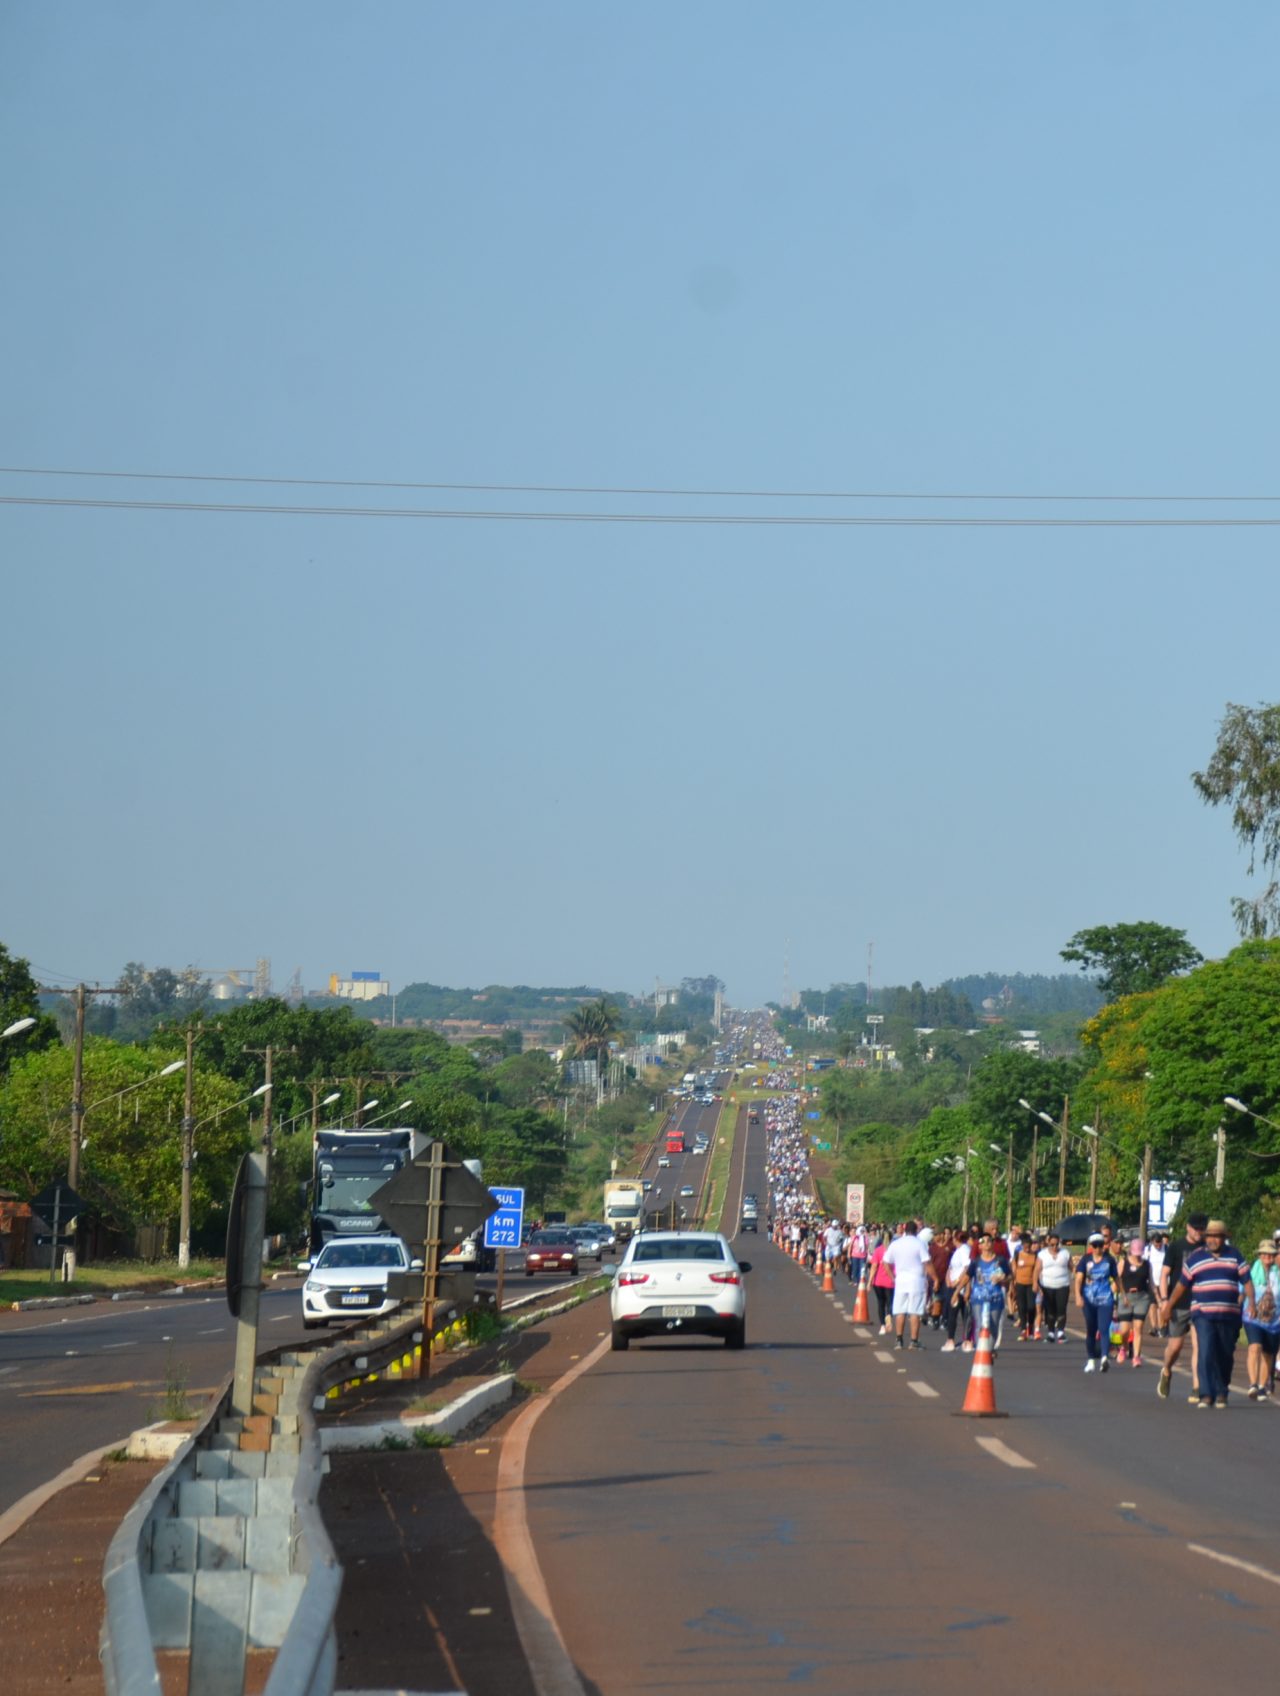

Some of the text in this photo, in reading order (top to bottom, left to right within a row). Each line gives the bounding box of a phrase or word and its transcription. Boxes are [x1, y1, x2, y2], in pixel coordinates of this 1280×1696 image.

[495, 1194, 516, 1205] SUL
[340, 1219, 373, 1228] SCANIA
[494, 1215, 515, 1227] km
[491, 1231, 515, 1242] 272
